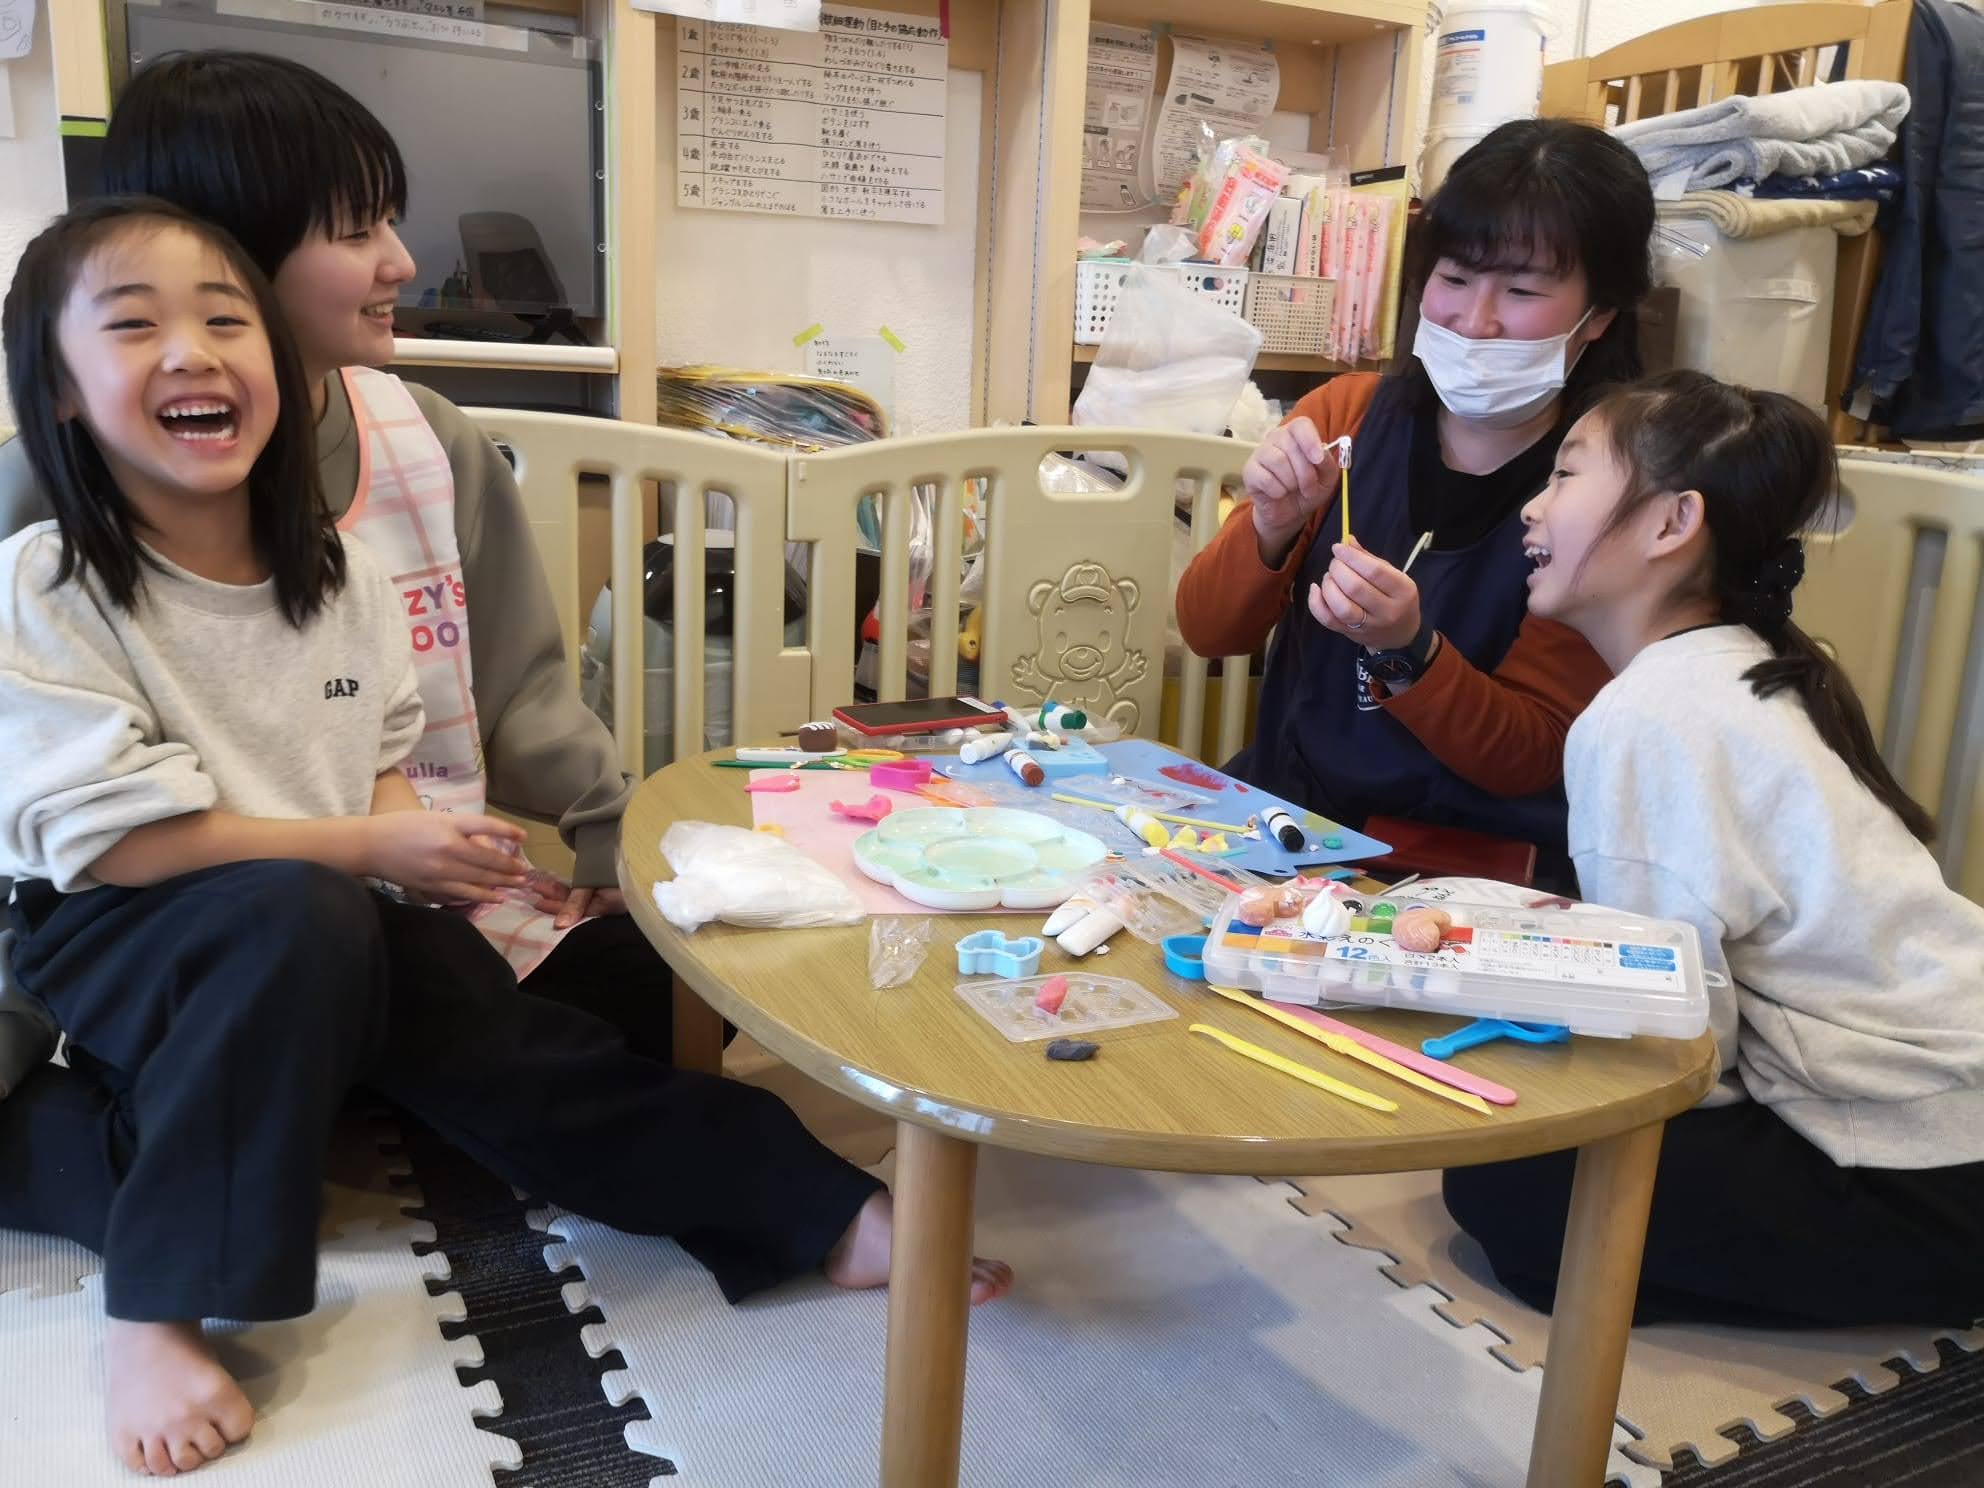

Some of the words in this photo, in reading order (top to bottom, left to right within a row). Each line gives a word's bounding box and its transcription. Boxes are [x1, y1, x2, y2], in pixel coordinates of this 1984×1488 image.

[682, 26, 700, 41] 1歳
[682, 65, 700, 80] 2歳
[682, 105, 701, 121] 3歳
[682, 147, 701, 160] 4歳
[682, 183, 701, 197] 5歳
[324, 678, 360, 700] GAP
